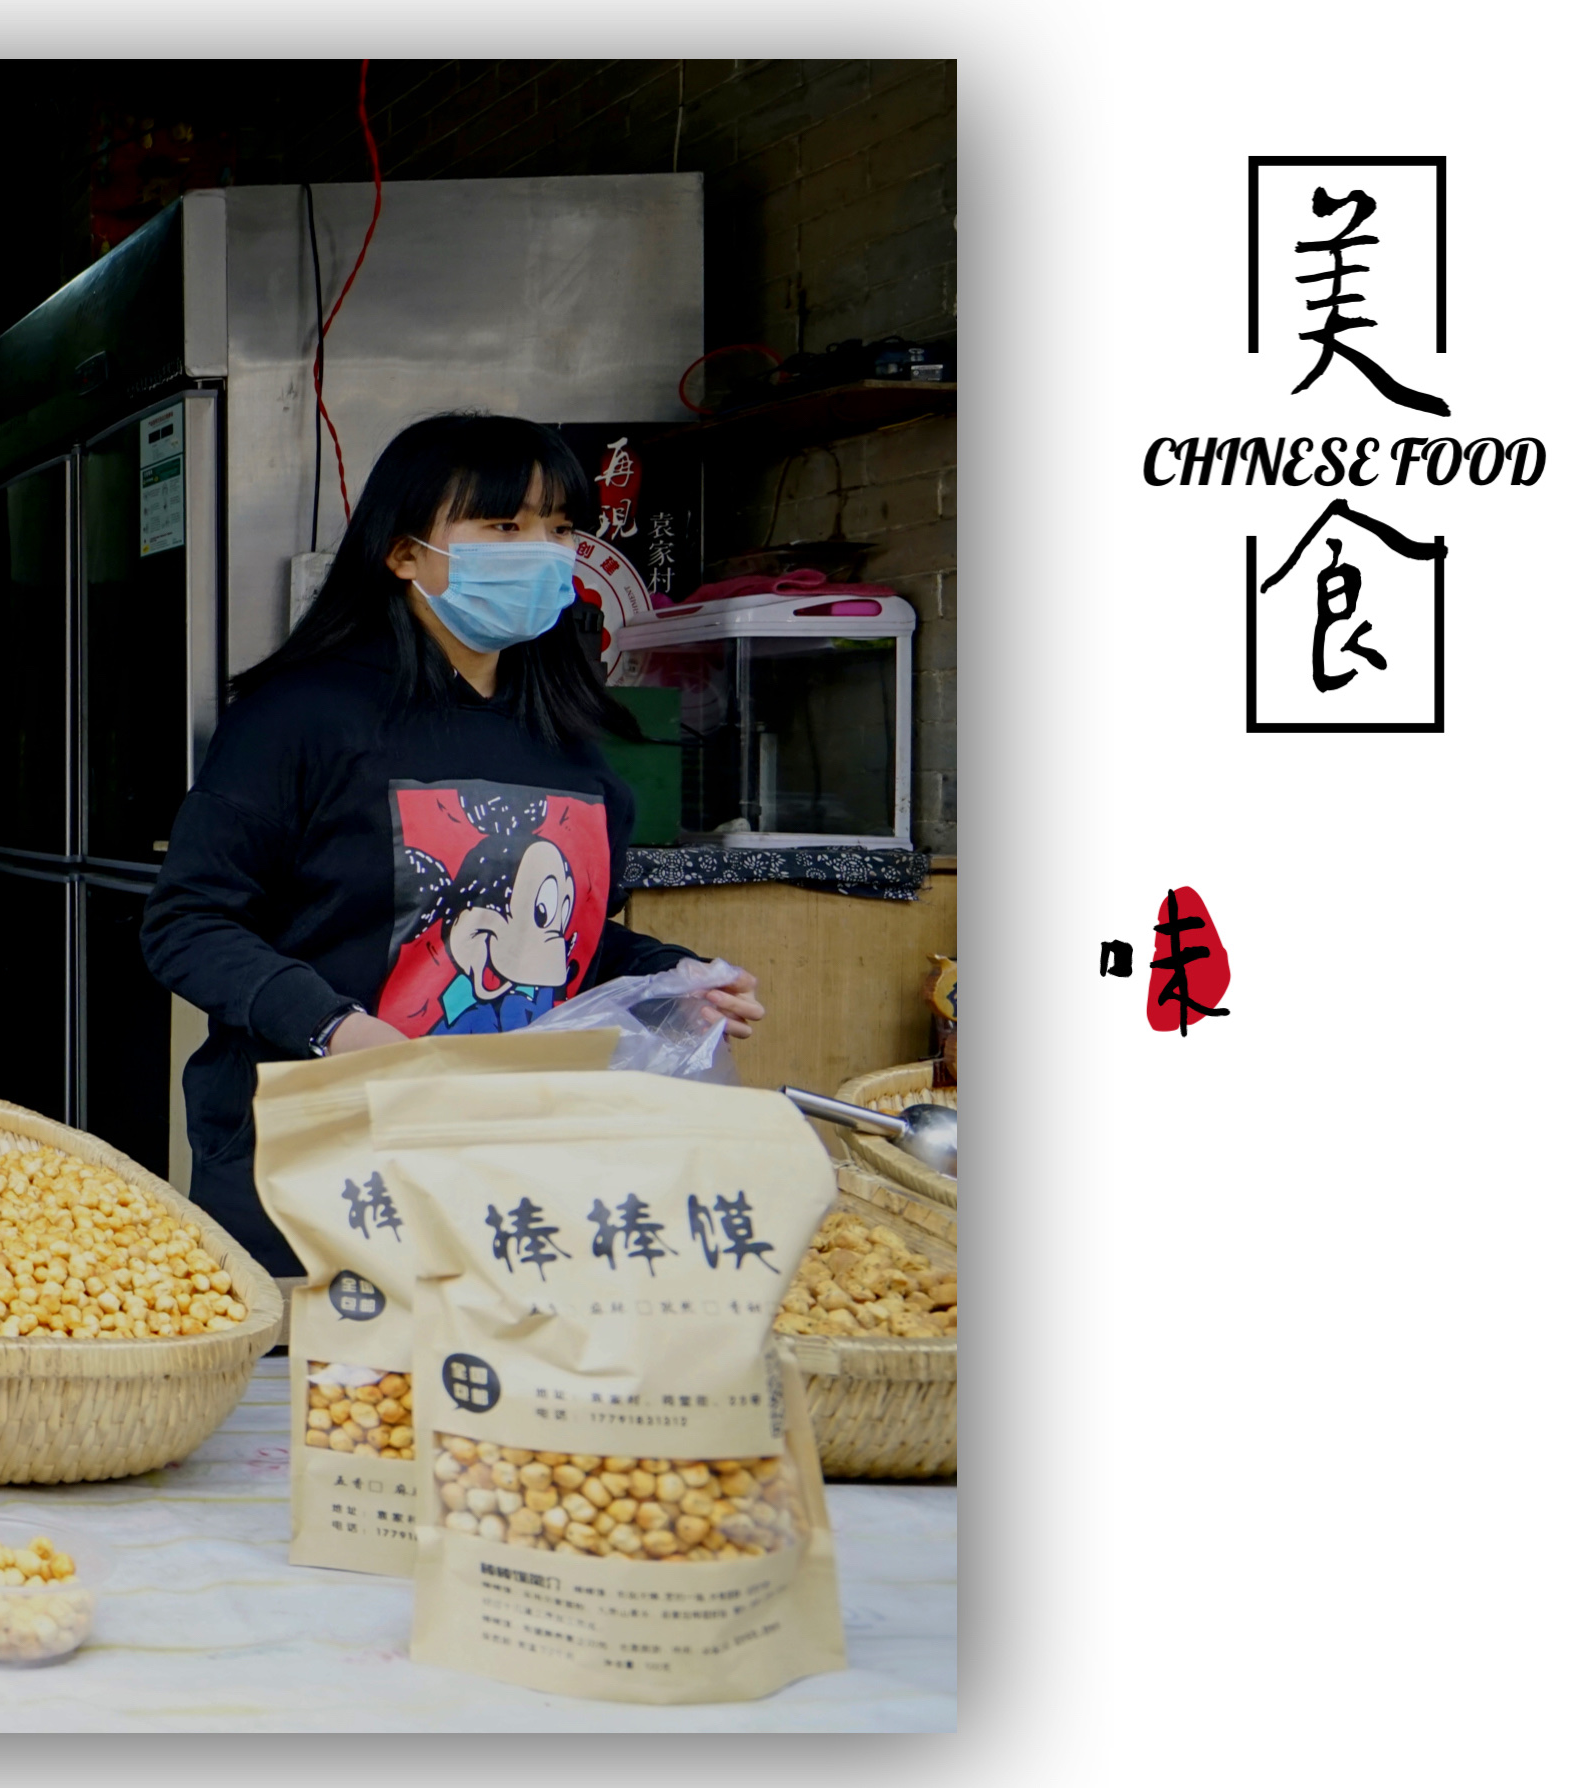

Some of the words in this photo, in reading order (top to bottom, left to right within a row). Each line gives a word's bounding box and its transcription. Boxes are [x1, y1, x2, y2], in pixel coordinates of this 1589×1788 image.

[646, 511, 676, 595] 袁家村
[484, 1190, 782, 1282] 棒棒馍
